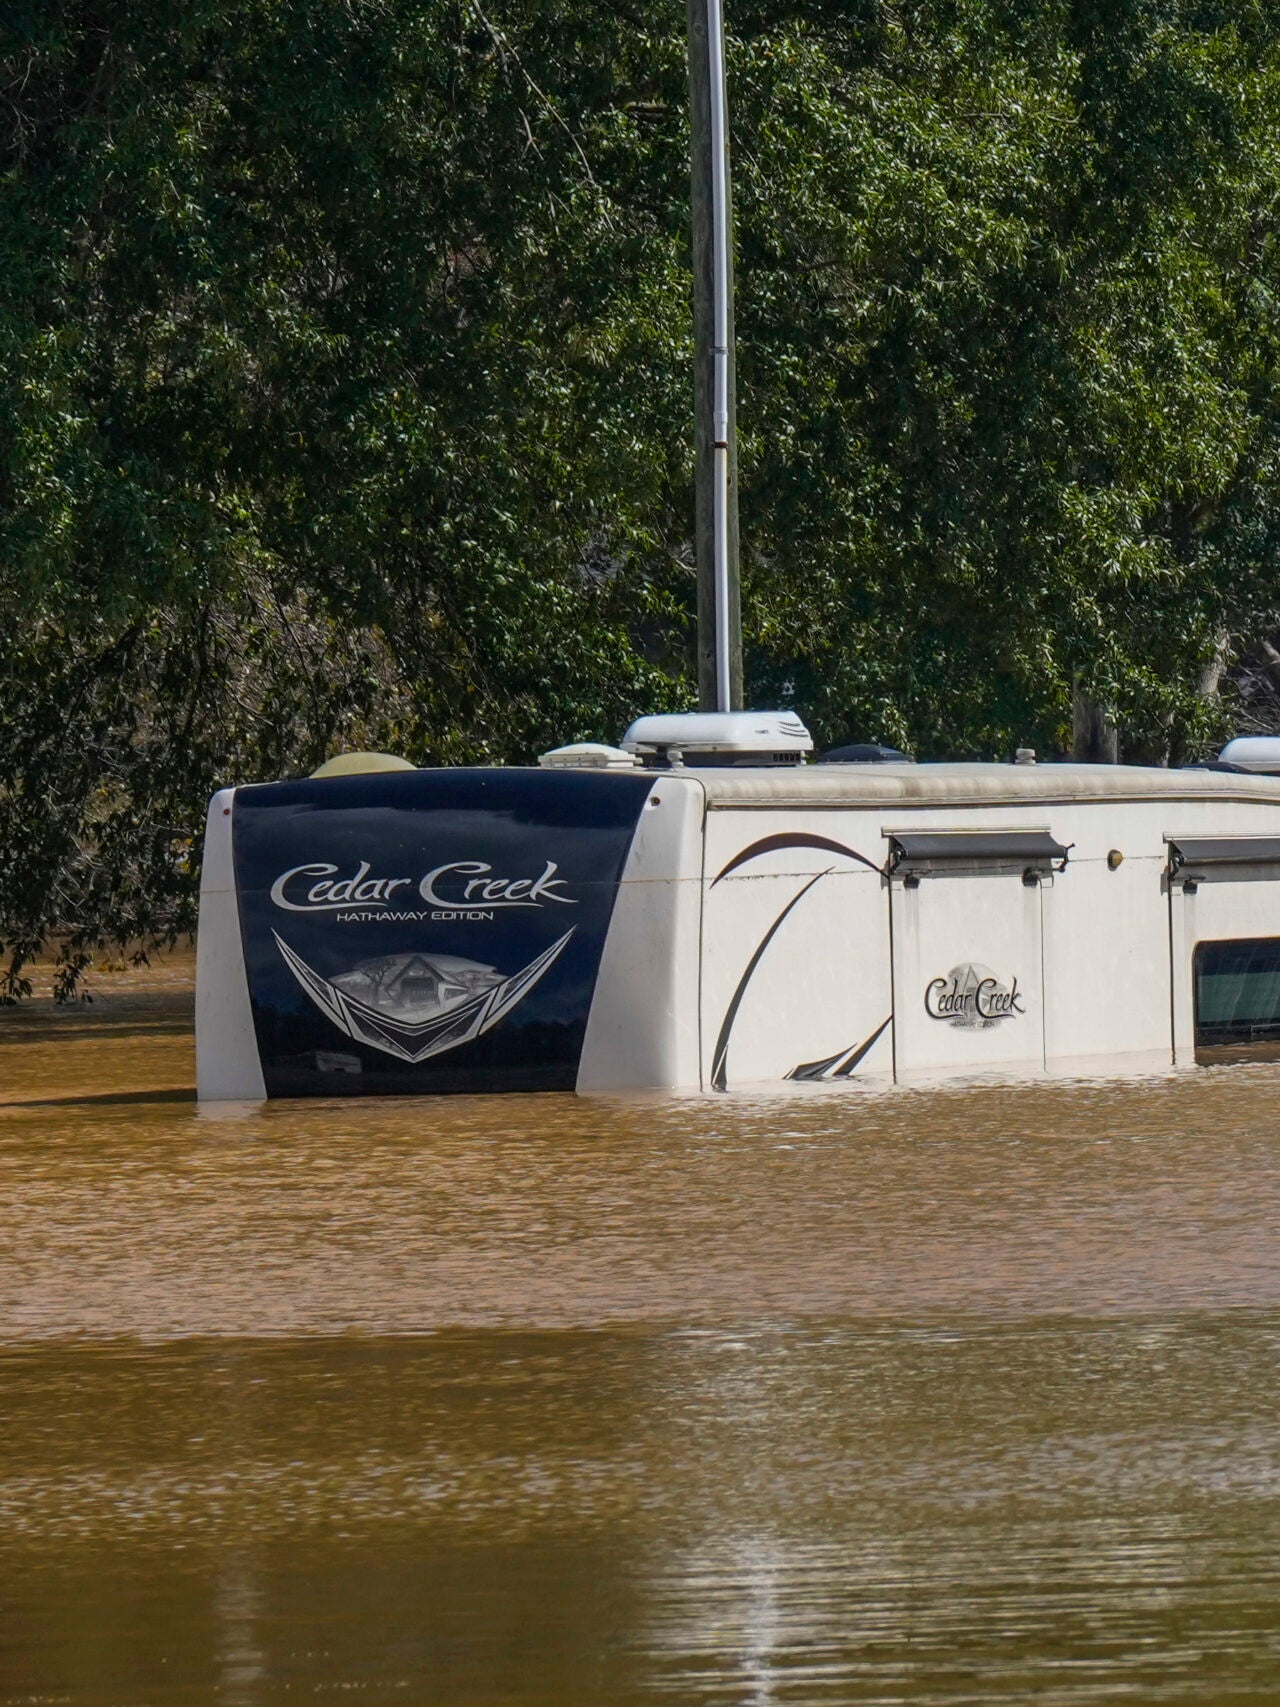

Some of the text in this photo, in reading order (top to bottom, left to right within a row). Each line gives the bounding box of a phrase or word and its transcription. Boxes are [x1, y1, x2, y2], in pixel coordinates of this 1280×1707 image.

[270, 859, 579, 912] Cedar Creek
[336, 910, 494, 922] HATHAWAY EDITION
[924, 976, 1026, 1019] Cedar Creek
